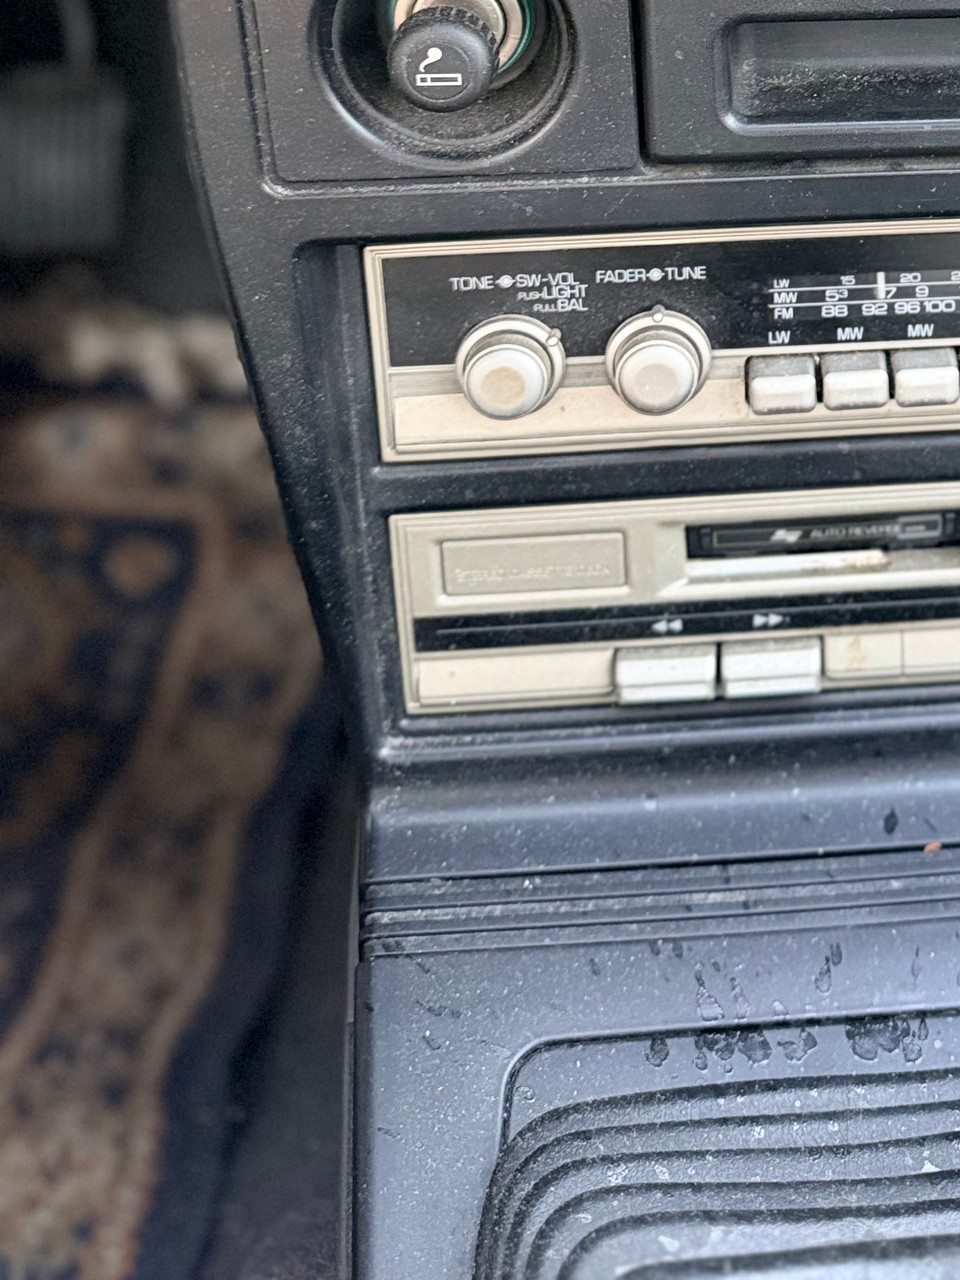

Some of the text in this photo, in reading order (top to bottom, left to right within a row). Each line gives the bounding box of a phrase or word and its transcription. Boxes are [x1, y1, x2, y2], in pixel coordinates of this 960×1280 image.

[449, 272, 580, 292] TONE SW-VOL
[595, 265, 707, 284] FADER TUNE
[773, 278, 790, 289] LW
[840, 275, 856, 285] 15
[900, 272, 921, 283] 20
[543, 284, 589, 299] LIGHT
[773, 291, 798, 304] MW
[915, 285, 930, 297] 9
[557, 298, 589, 312] BAL
[773, 307, 794, 320] FM
[821, 304, 848, 318] 88
[861, 303, 888, 316] 92
[894, 300, 921, 314] 96
[922, 300, 956, 313] 100
[768, 330, 791, 344] LW
[837, 326, 864, 341] MW
[907, 323, 934, 338] MW
